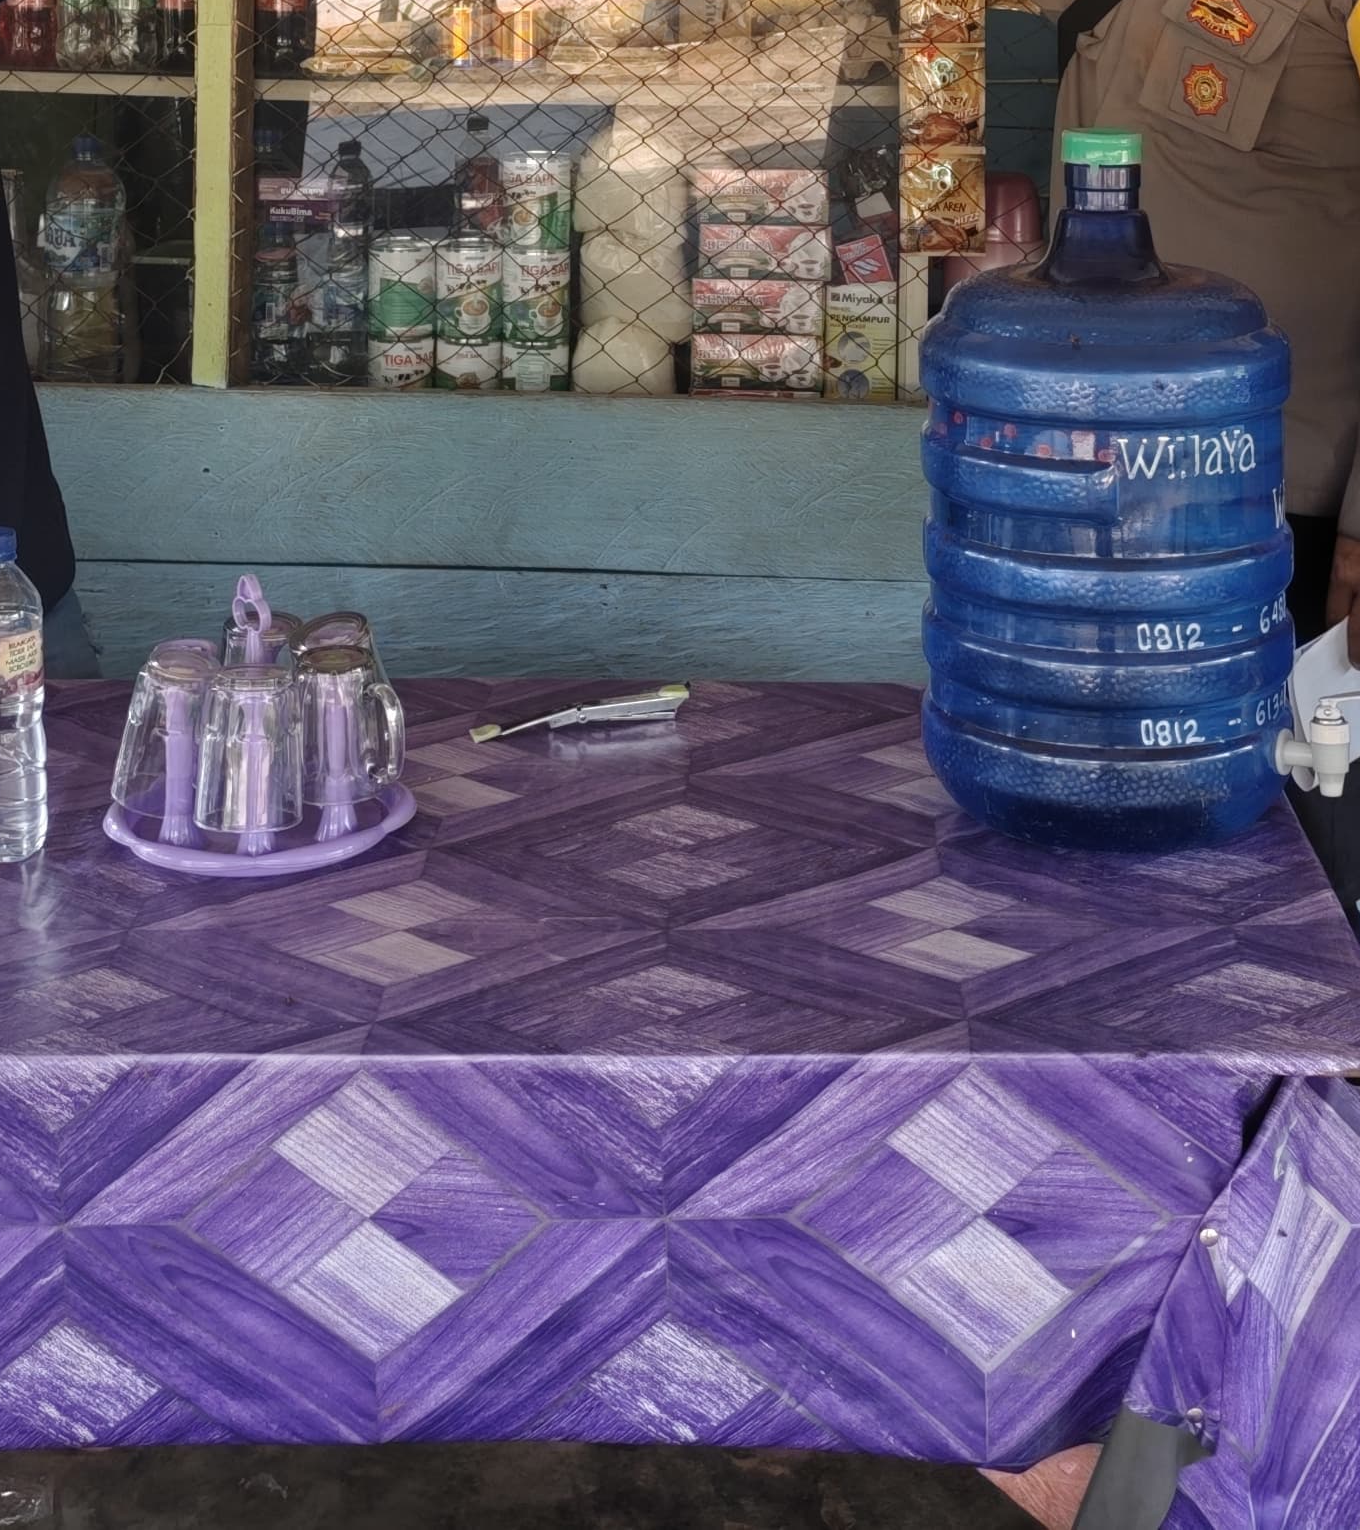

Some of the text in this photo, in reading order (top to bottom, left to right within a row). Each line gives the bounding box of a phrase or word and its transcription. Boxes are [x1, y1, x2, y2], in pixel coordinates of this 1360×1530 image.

[270, 208, 312, 216] KukuBima
[447, 263, 472, 276] TIGA
[520, 264, 547, 276] TIGA
[384, 353, 413, 367] TIGA
[1137, 622, 1205, 651] 0812
[1141, 719, 1205, 746] 0812
